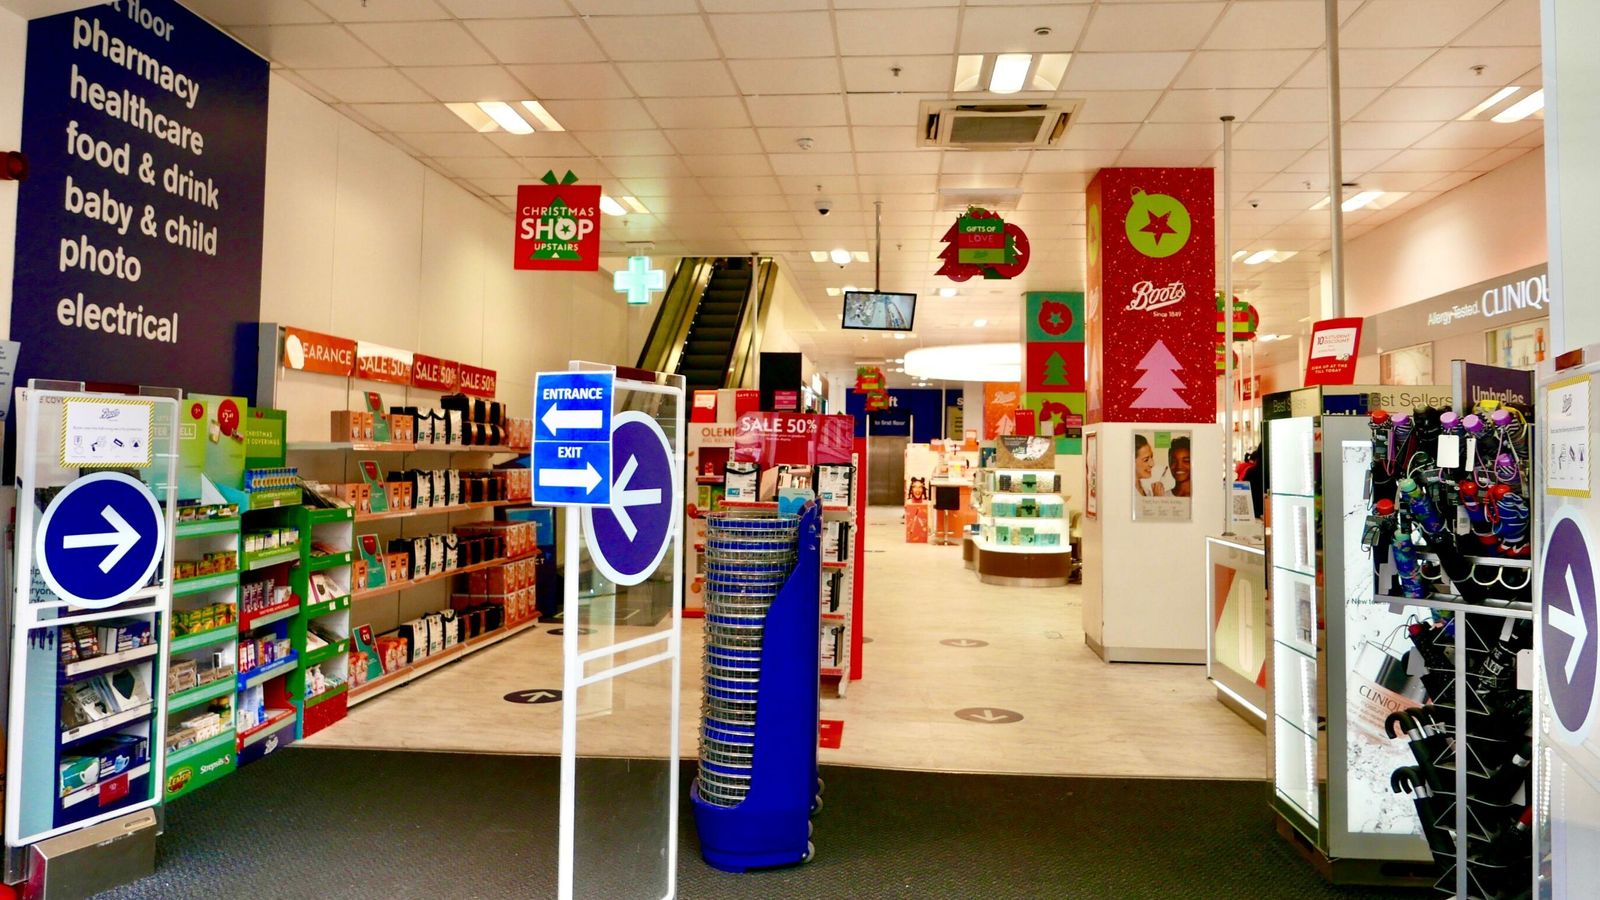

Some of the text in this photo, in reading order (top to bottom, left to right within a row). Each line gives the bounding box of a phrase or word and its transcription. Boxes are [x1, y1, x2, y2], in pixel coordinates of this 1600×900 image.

[128, 0, 174, 42] floor
[73, 16, 200, 109] pharmacy
[70, 64, 204, 155] healthcare
[66, 120, 219, 210] food & drink
[65, 176, 218, 256] baby & child
[522, 206, 594, 217] CHRISTMAS
[520, 216, 594, 241] SHOP
[968, 235, 994, 243] LOVE
[59, 235, 141, 281] photo
[534, 243, 579, 251] UPSTAIRS
[1125, 280, 1186, 312] Boots
[1482, 274, 1550, 318] CLINIQU
[57, 293, 178, 343] electrical
[303, 341, 352, 366] EARANCE
[415, 361, 438, 382] SALE
[460, 370, 480, 390] SALE
[543, 387, 603, 400] ENTRANCE
[1400, 392, 1453, 408] Sellers
[1472, 385, 1524, 406] Umbrellas
[180, 429, 194, 437] ELL
[741, 416, 783, 433] SALE
[557, 446, 583, 459] EXIT
[1359, 685, 1402, 714] CLINIQ
